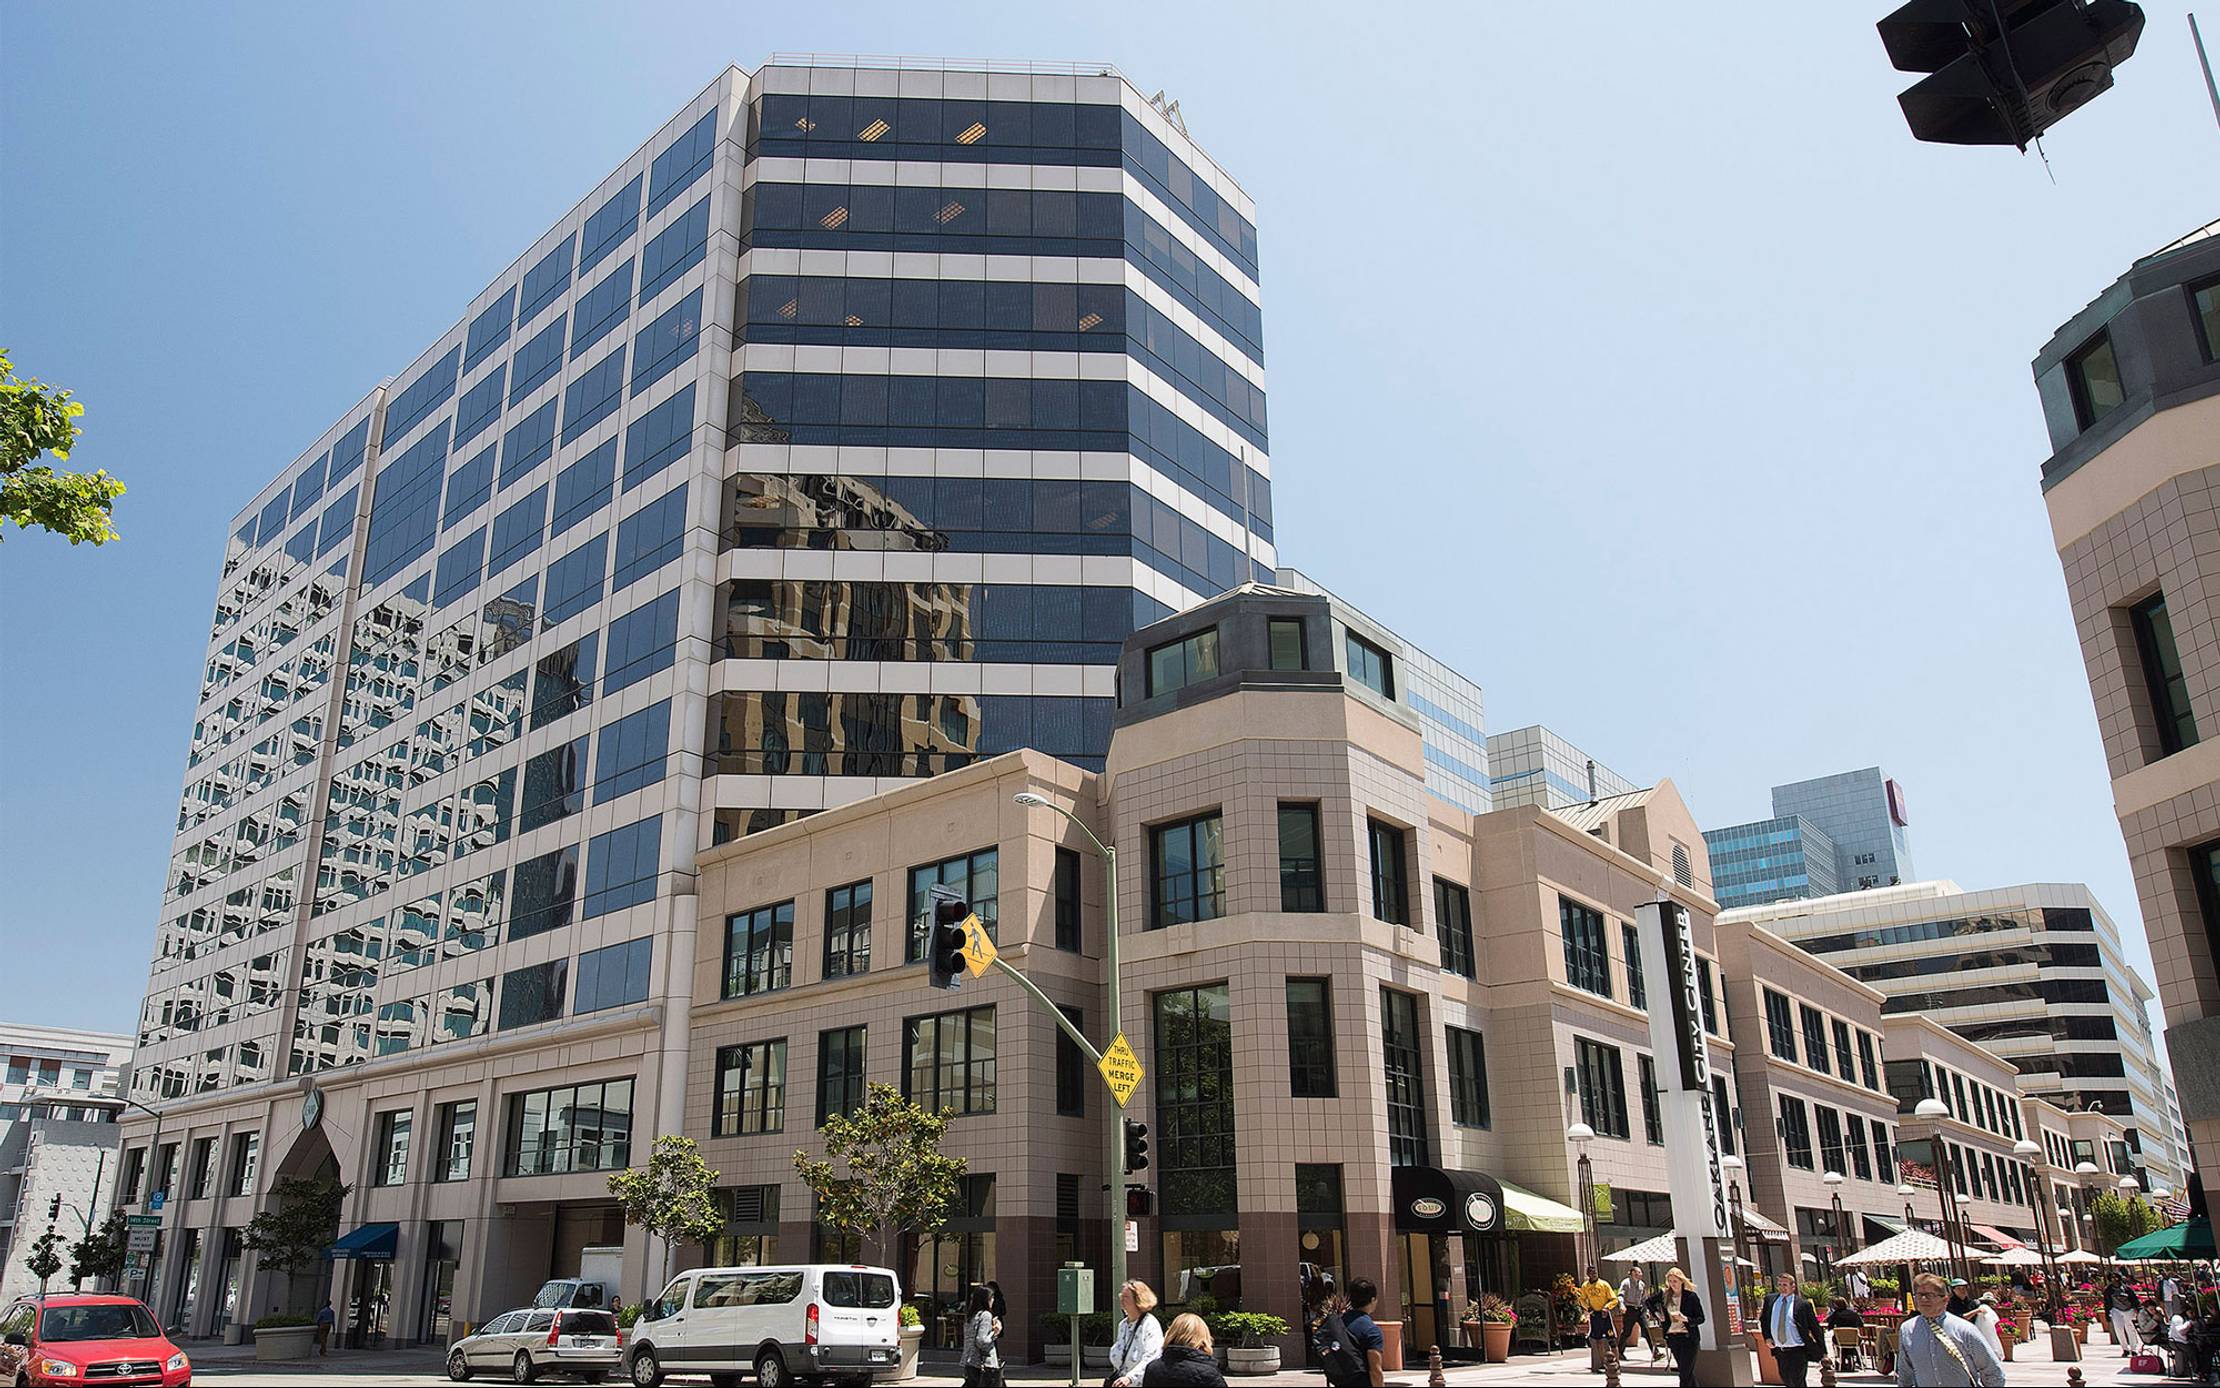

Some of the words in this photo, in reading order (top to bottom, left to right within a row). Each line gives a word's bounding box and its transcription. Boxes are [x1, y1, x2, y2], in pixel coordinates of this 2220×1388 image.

[1676, 908, 1698, 1012] CENTER
[1114, 1045, 1128, 1056] THRU
[1692, 1020, 1708, 1083] CITY
[1108, 1057, 1135, 1069] TRAFFIC
[1108, 1070, 1135, 1082] MERGE
[1113, 1083, 1130, 1093] LEFT
[1700, 1095, 1725, 1230] OAKLAND
